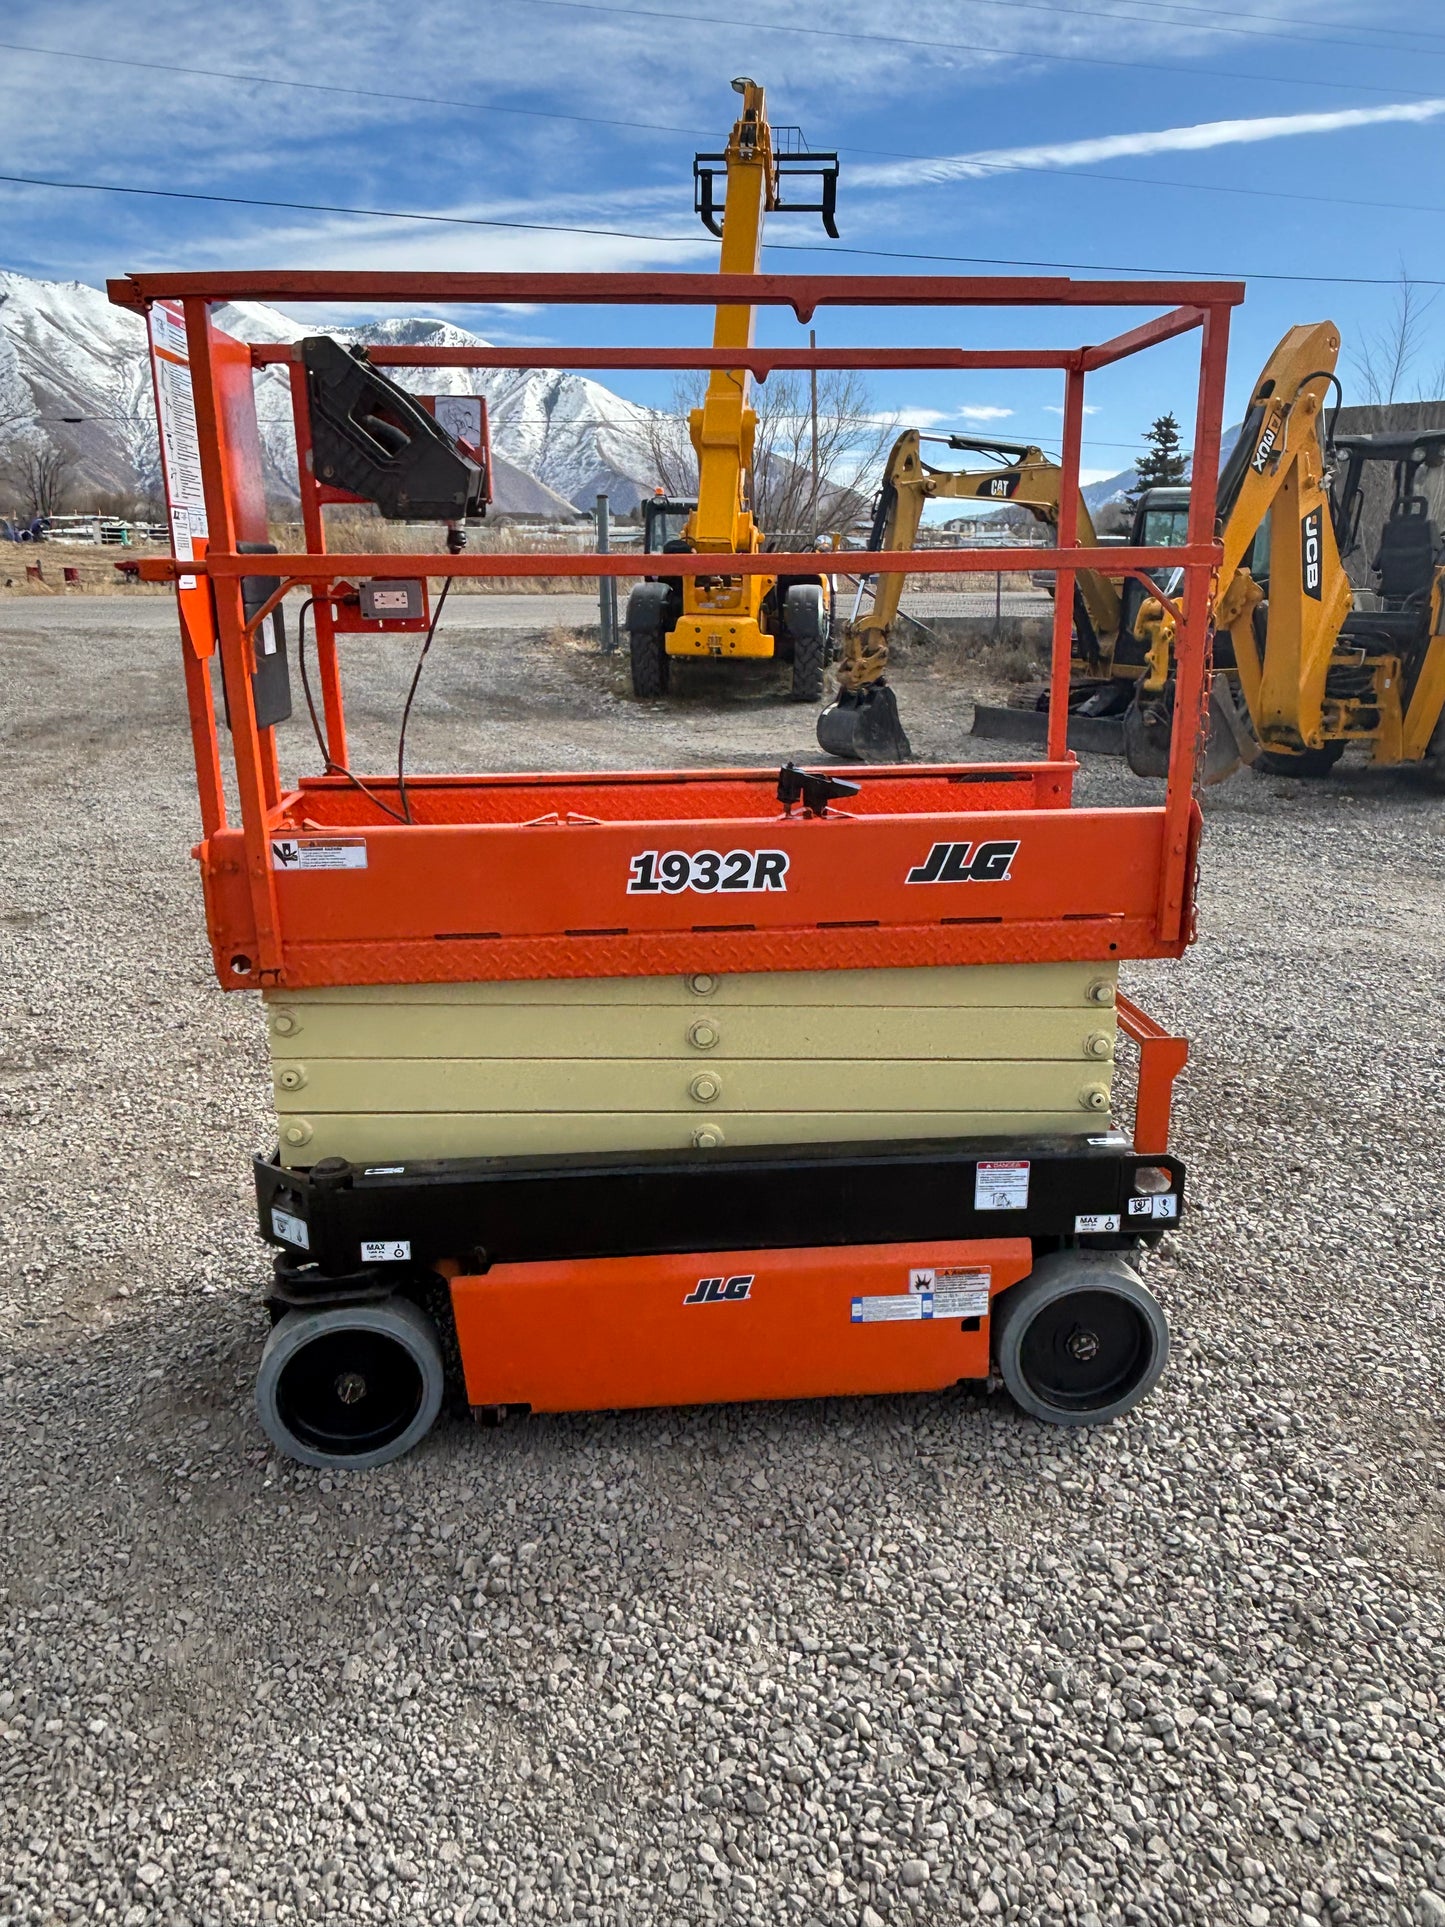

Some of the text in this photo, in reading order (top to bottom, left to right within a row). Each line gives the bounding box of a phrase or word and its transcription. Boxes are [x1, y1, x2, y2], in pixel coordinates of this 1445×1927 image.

[991, 480, 1009, 497] CAT
[1305, 514, 1319, 589] JCB
[628, 851, 788, 893] 1932R
[905, 840, 1021, 884] JLG
[366, 1243, 385, 1251] MAX
[683, 1275, 755, 1304] JLG
